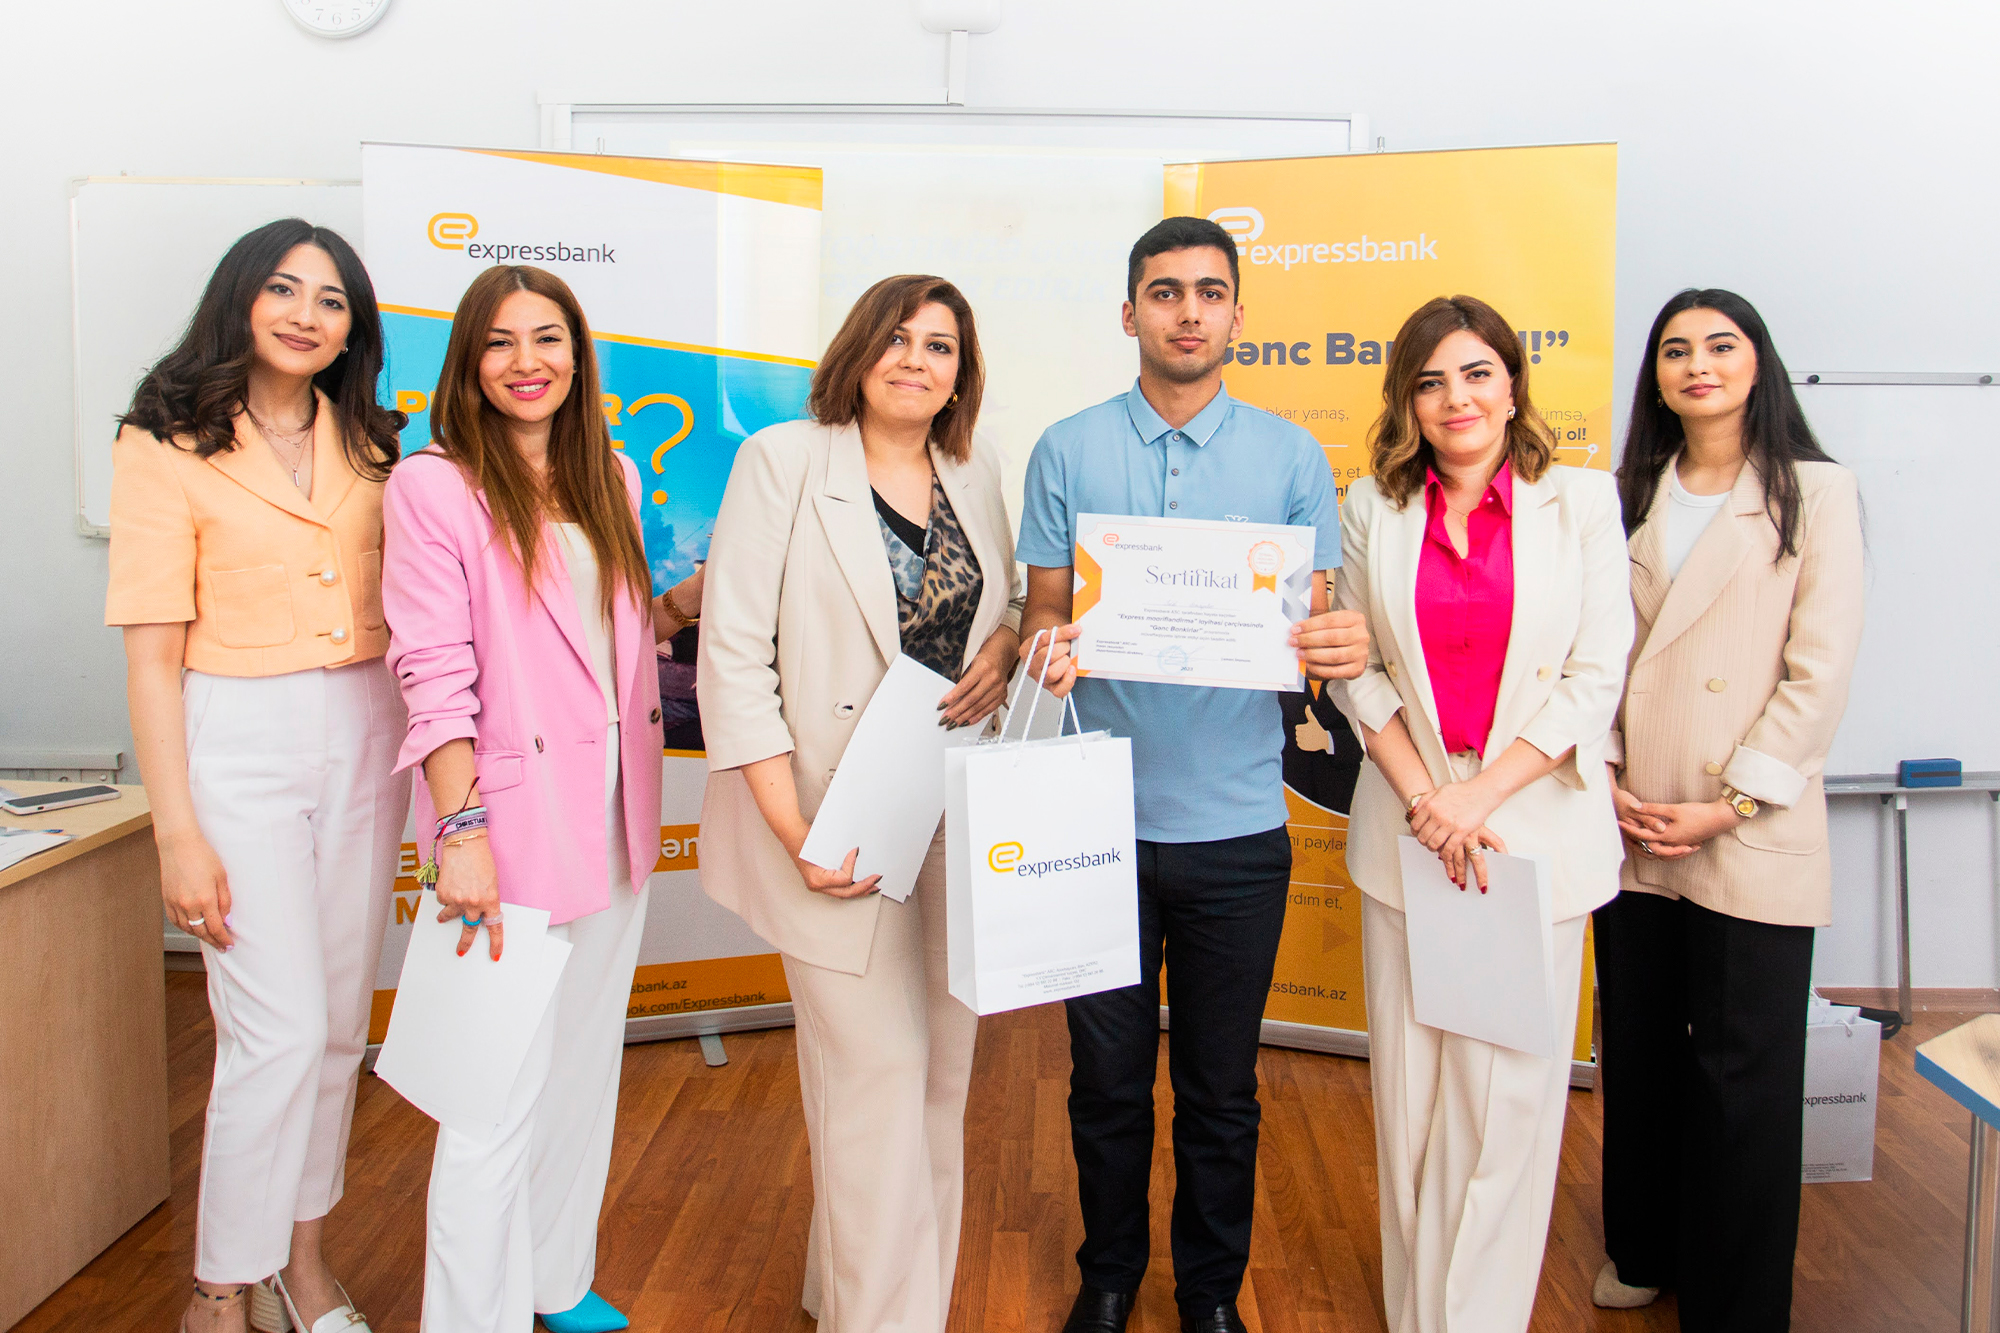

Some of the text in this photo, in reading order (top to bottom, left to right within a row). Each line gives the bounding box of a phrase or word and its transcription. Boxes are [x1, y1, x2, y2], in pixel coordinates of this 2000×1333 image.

[468, 241, 616, 264] expressbank
[1250, 233, 1438, 270] expressbank
[1302, 409, 1349, 422] yanaş,
[1540, 407, 1587, 422] ümsə,
[1567, 427, 1587, 440] ol!
[1115, 541, 1163, 552] expressbank
[1145, 564, 1240, 590] Sertifikat
[1018, 847, 1122, 878] expressbank
[1288, 893, 1343, 910] rdım et,
[631, 980, 688, 994] sbank.az
[1270, 981, 1347, 1001] ssbank.az
[627, 991, 767, 1015] ok.com/Expressbank
[1804, 1092, 1867, 1107] xpressbank
